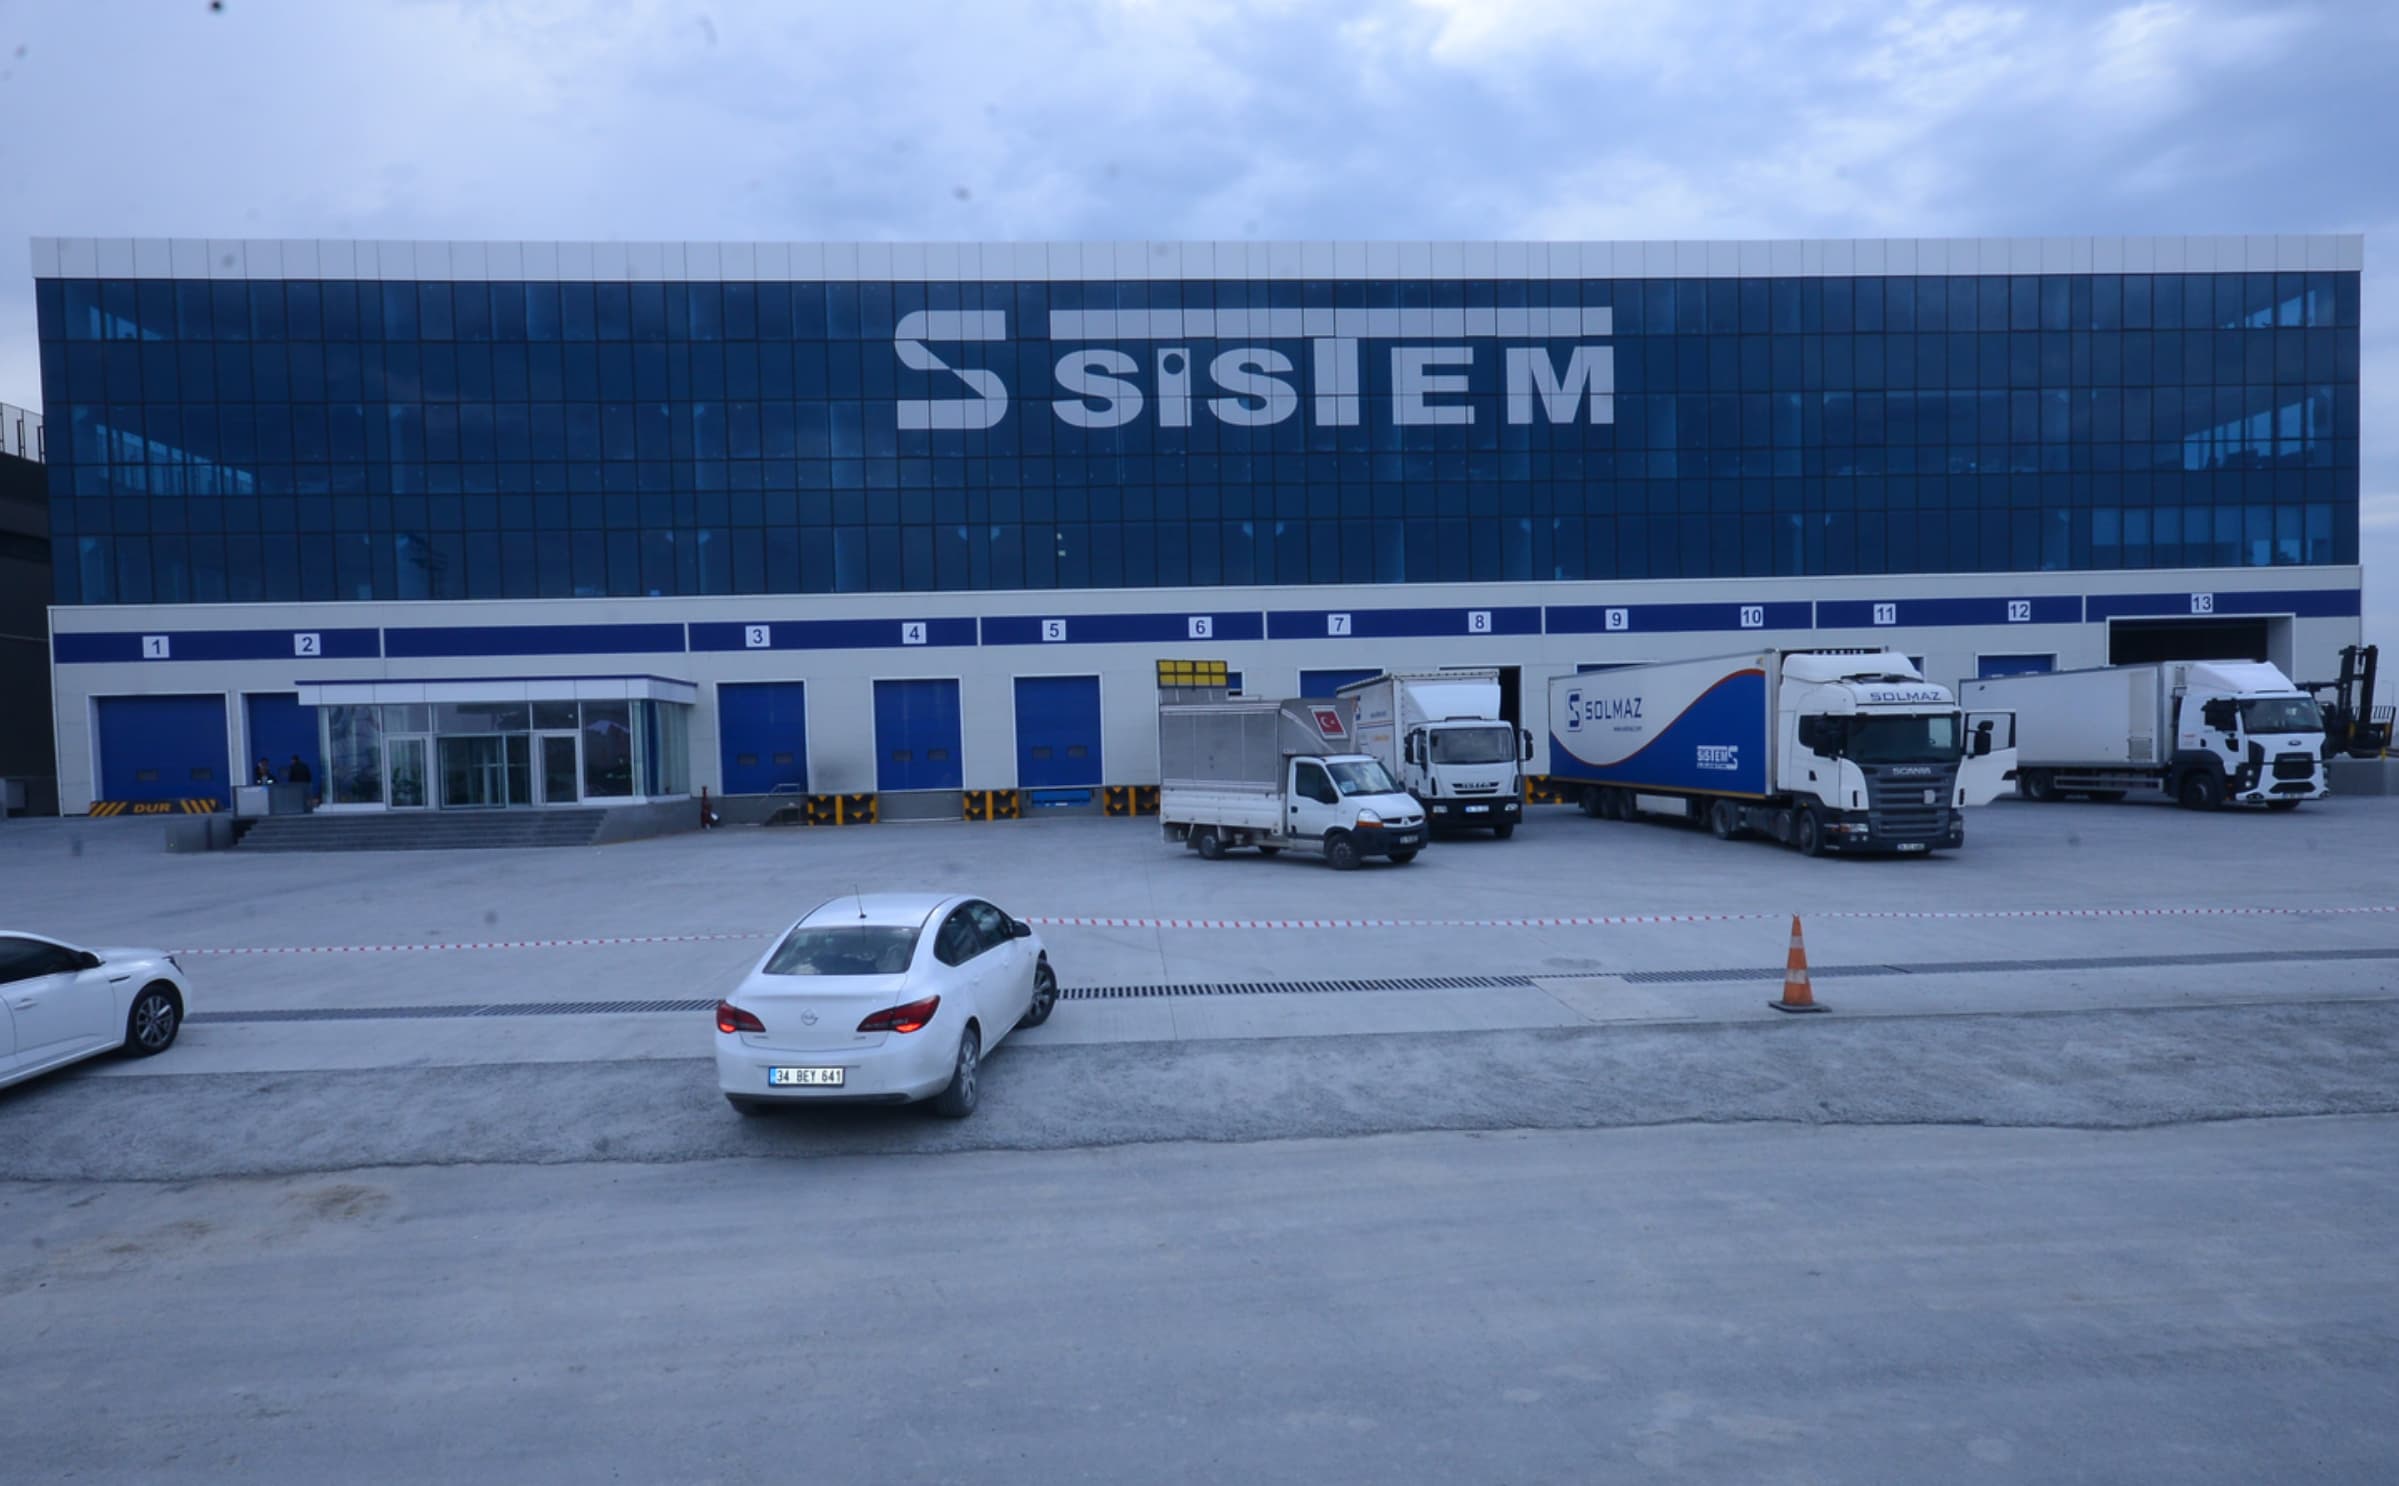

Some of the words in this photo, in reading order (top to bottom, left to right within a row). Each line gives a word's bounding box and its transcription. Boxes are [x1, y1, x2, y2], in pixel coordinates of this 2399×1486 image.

[2010, 603, 2029, 619] 12
[2193, 595, 2212, 611] 13
[1474, 614, 1485, 630] 8
[1611, 611, 1622, 627] 9
[1742, 609, 1762, 625] 10
[1876, 606, 1894, 622] 11
[1049, 622, 1060, 638] 5
[1195, 619, 1206, 635] 6
[1334, 616, 1345, 633] 7
[752, 628, 764, 645] 3
[908, 625, 920, 641] 4
[301, 636, 314, 653] 2
[1870, 691, 1942, 702] SOLMAZ
[1585, 697, 1642, 720] SOLMAZ
[133, 803, 171, 813] DUR
[777, 1069, 790, 1082] 34
[821, 1069, 842, 1082] 641
